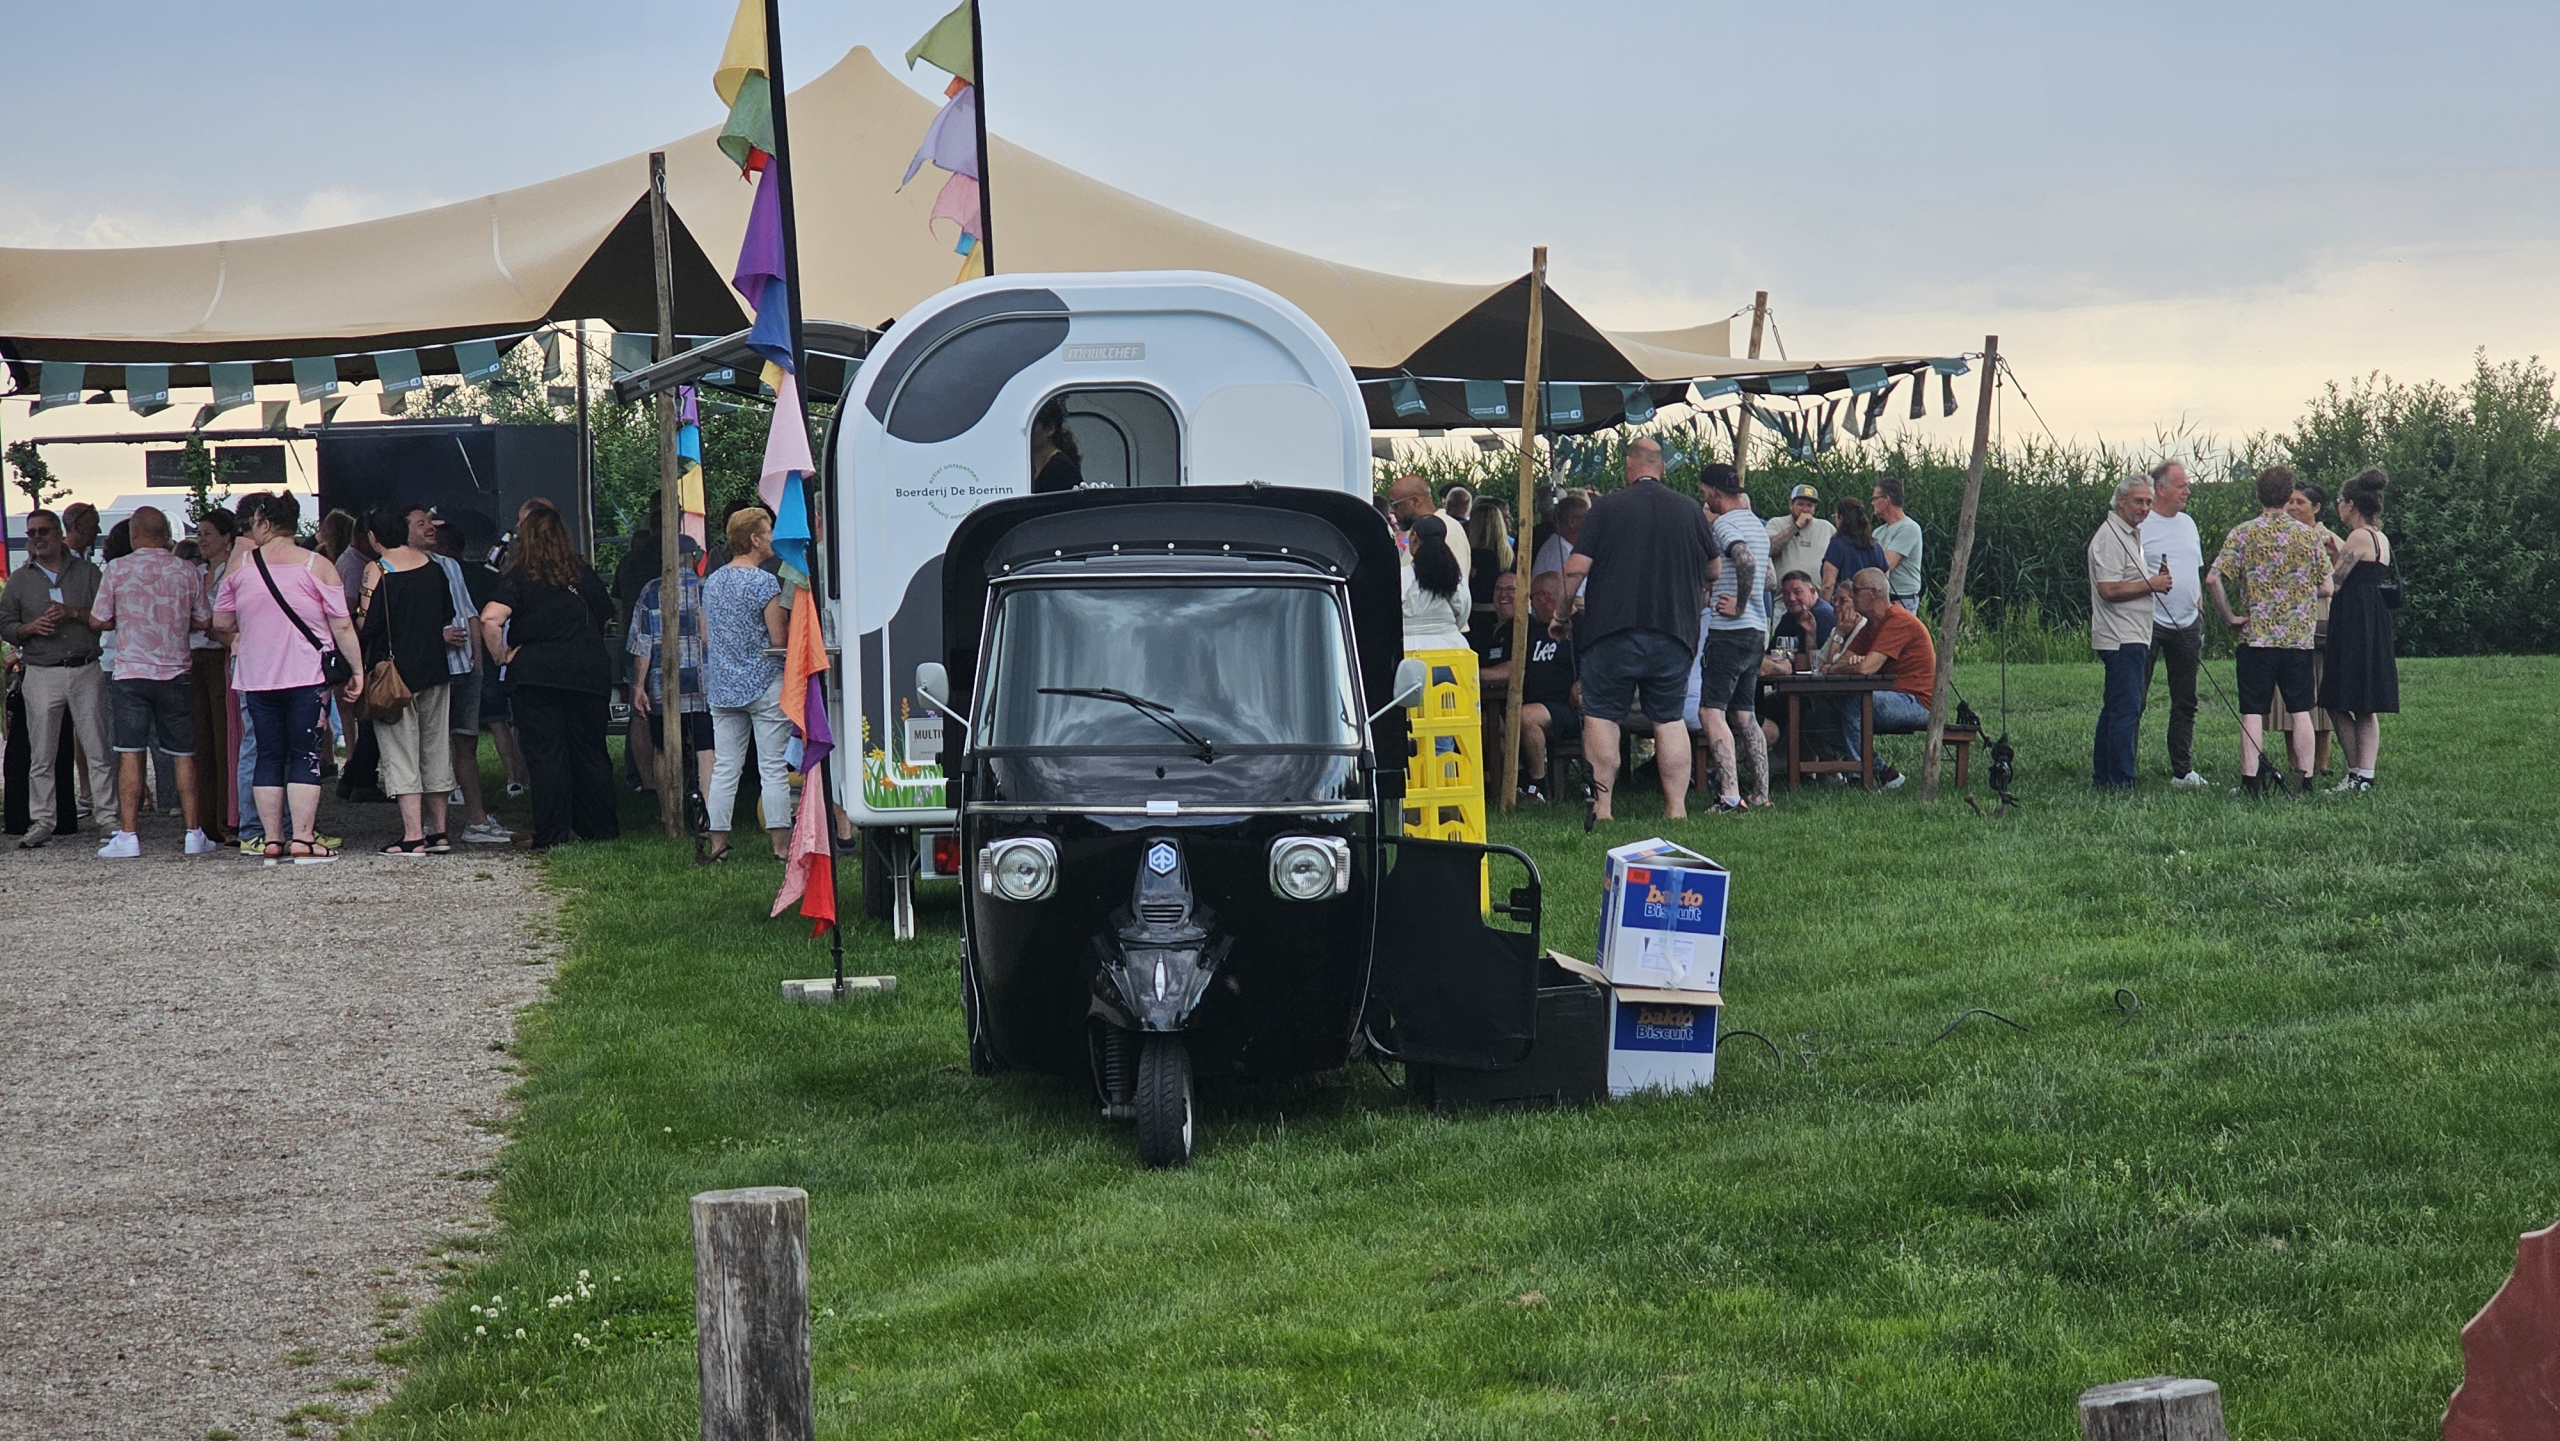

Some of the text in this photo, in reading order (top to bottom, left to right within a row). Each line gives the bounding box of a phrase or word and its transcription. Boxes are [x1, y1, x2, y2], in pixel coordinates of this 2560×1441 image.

[1068, 346, 1139, 359] MOBILCHEF
[929, 463, 980, 484] actief ontspannen
[895, 485, 1014, 498] Boerderij De Boerinn
[928, 500, 949, 520] gastvrij
[1532, 640, 1558, 661] Lee
[1637, 1007, 1695, 1027] bakto
[1636, 1024, 1694, 1041] Biscuit
